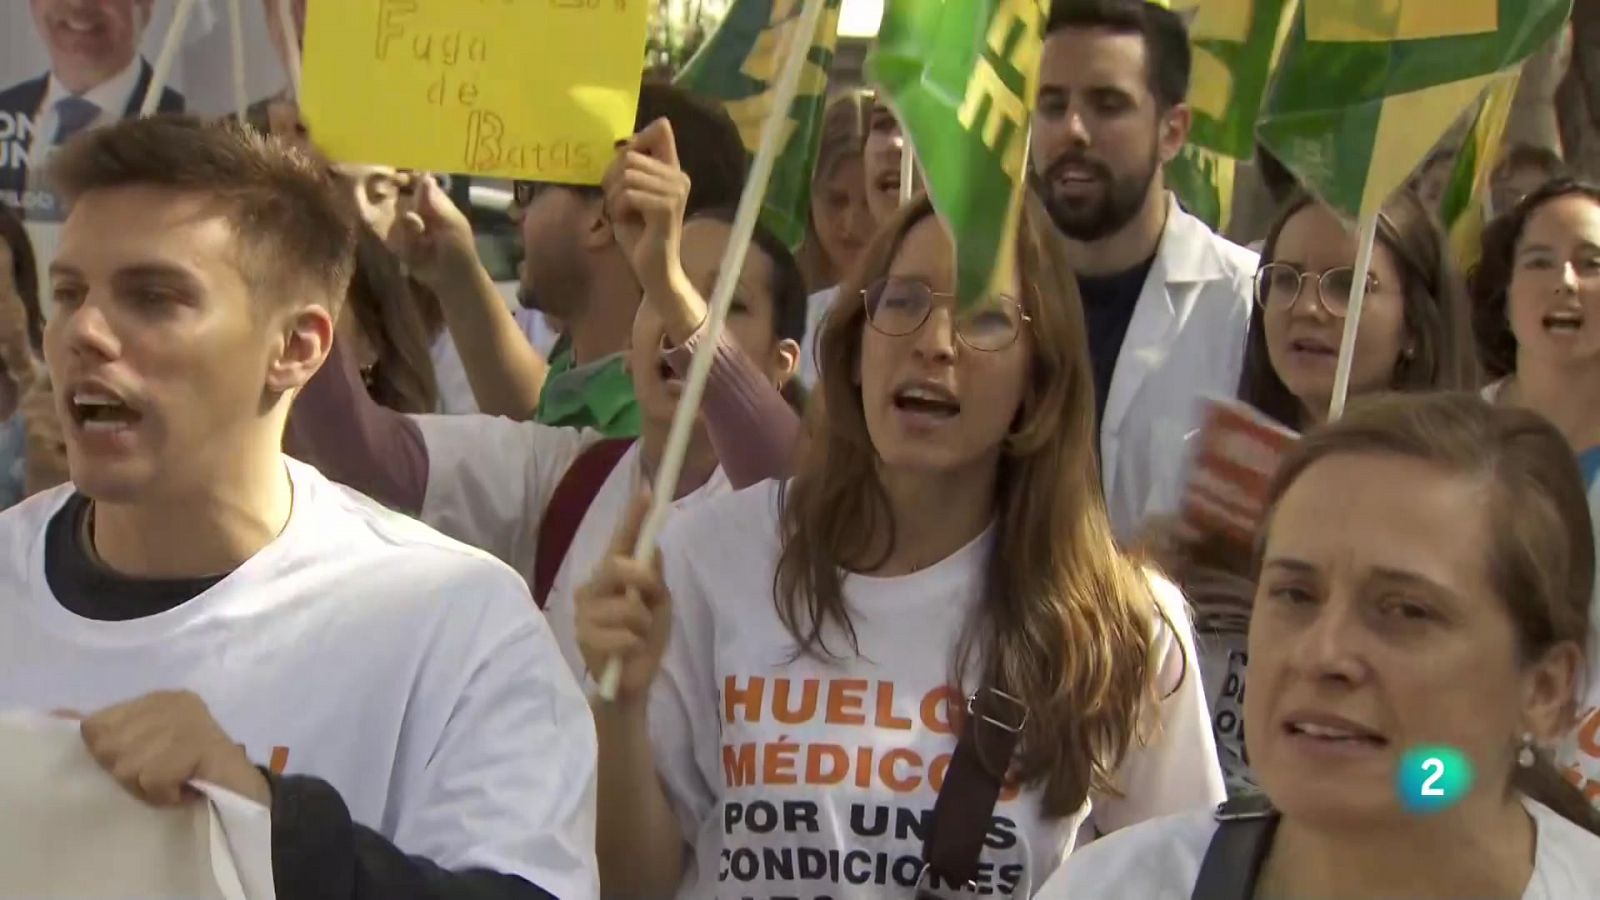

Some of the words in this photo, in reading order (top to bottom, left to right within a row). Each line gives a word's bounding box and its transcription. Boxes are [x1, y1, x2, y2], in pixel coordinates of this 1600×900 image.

[375, 0, 487, 66] Fuga
[464, 109, 592, 172] Batas
[724, 800, 820, 834] POR
[850, 803, 1018, 850] UNS
